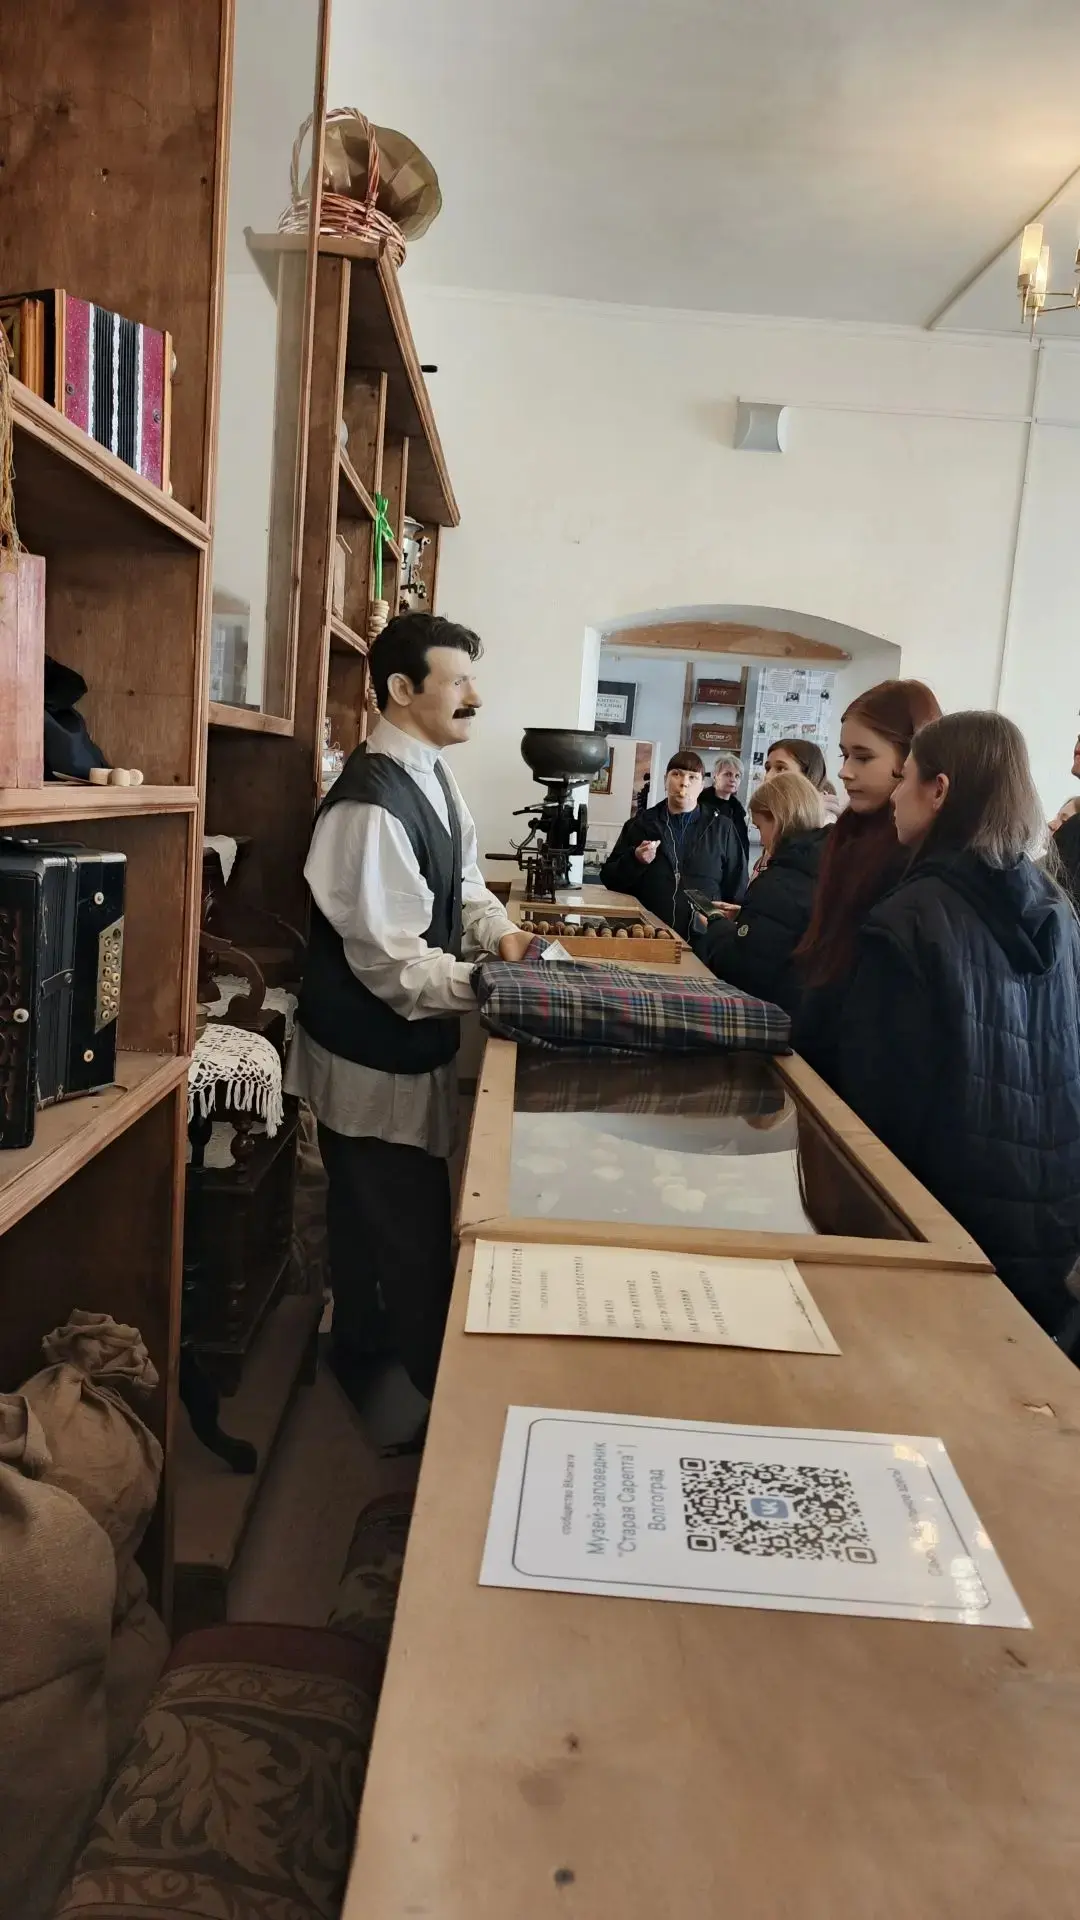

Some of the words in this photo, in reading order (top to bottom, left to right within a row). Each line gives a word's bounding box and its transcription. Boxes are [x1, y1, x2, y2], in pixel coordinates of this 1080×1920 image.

[586, 1442, 610, 1555] Музей-заповедник
[616, 1450, 638, 1503] Сарепта"
[647, 1469, 668, 1532] Волгоград
[560, 1489, 575, 1536] сообщество
[616, 1505, 637, 1558] "Старая
